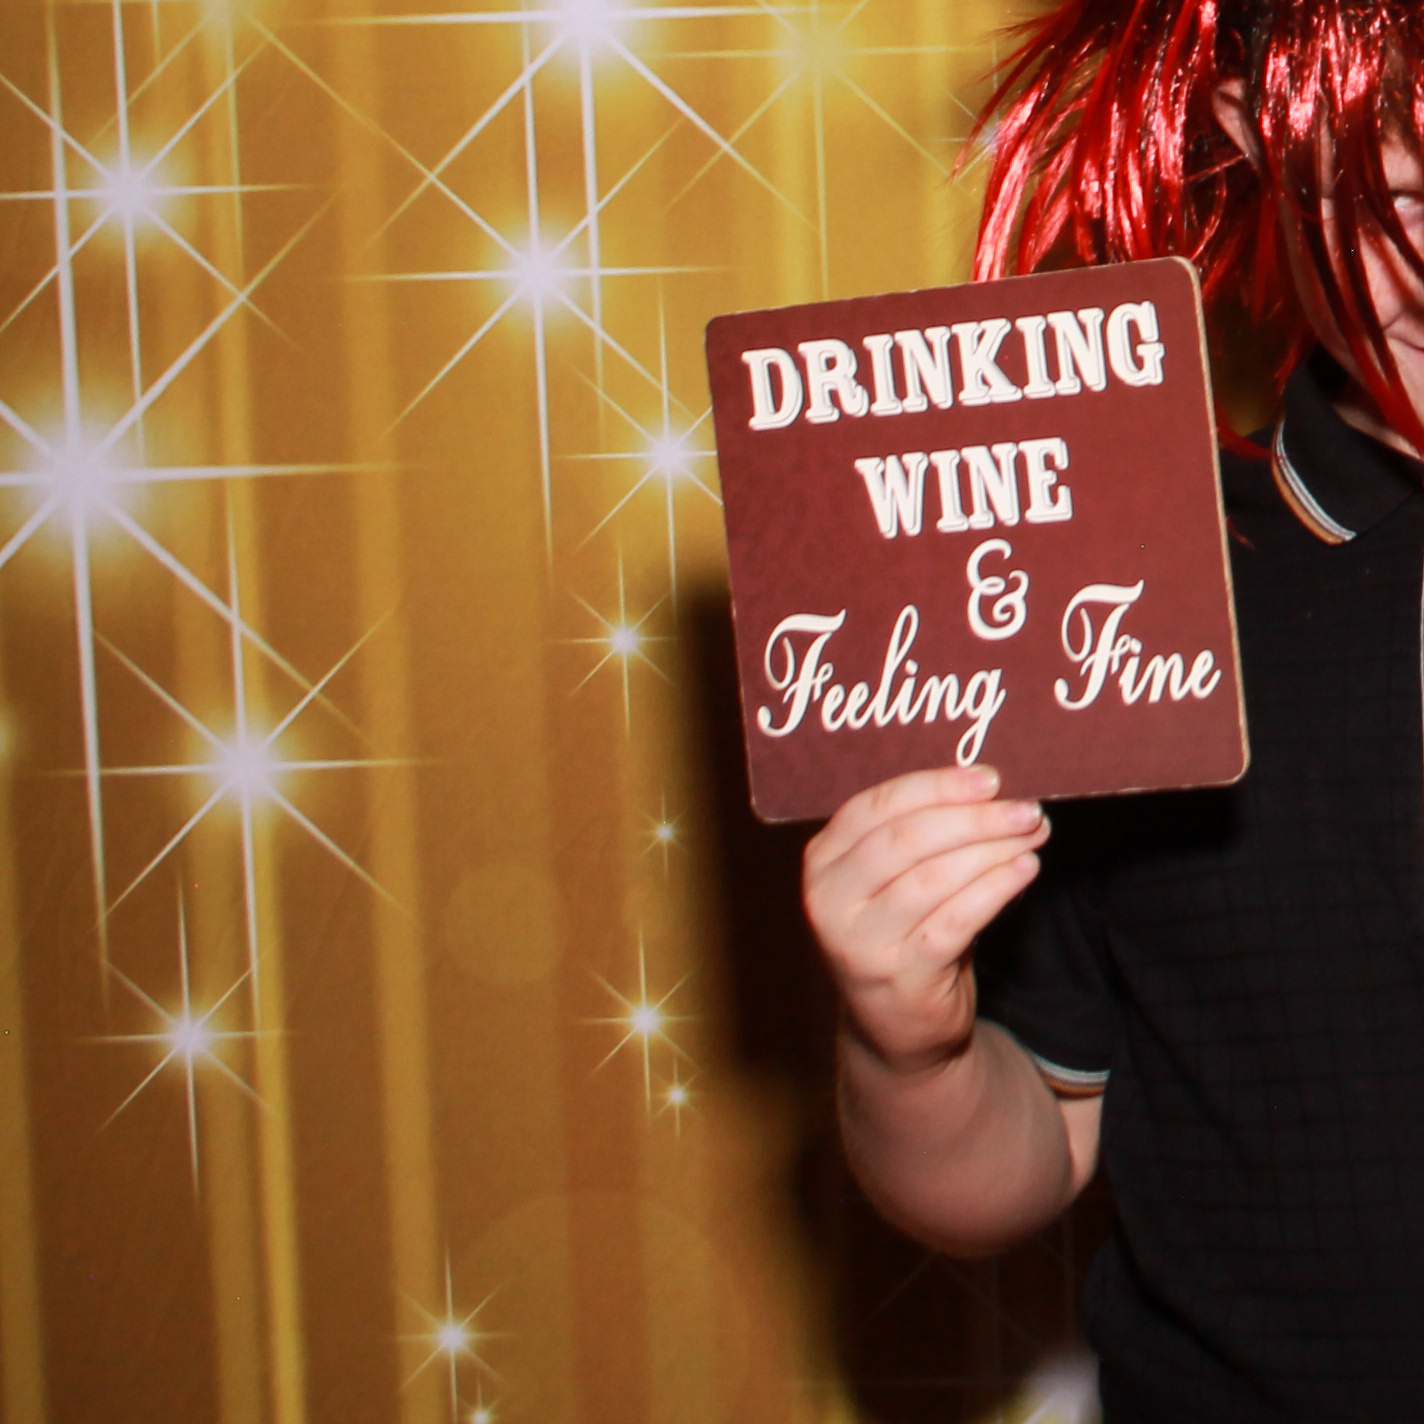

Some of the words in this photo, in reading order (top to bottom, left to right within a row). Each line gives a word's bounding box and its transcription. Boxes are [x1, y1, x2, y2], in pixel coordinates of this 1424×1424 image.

[742, 301, 1164, 431] DRINKING
[855, 437, 1073, 539] WINE
[965, 538, 1030, 640] &
[756, 604, 1006, 767] Feeling
[1054, 579, 1222, 710] Fine
